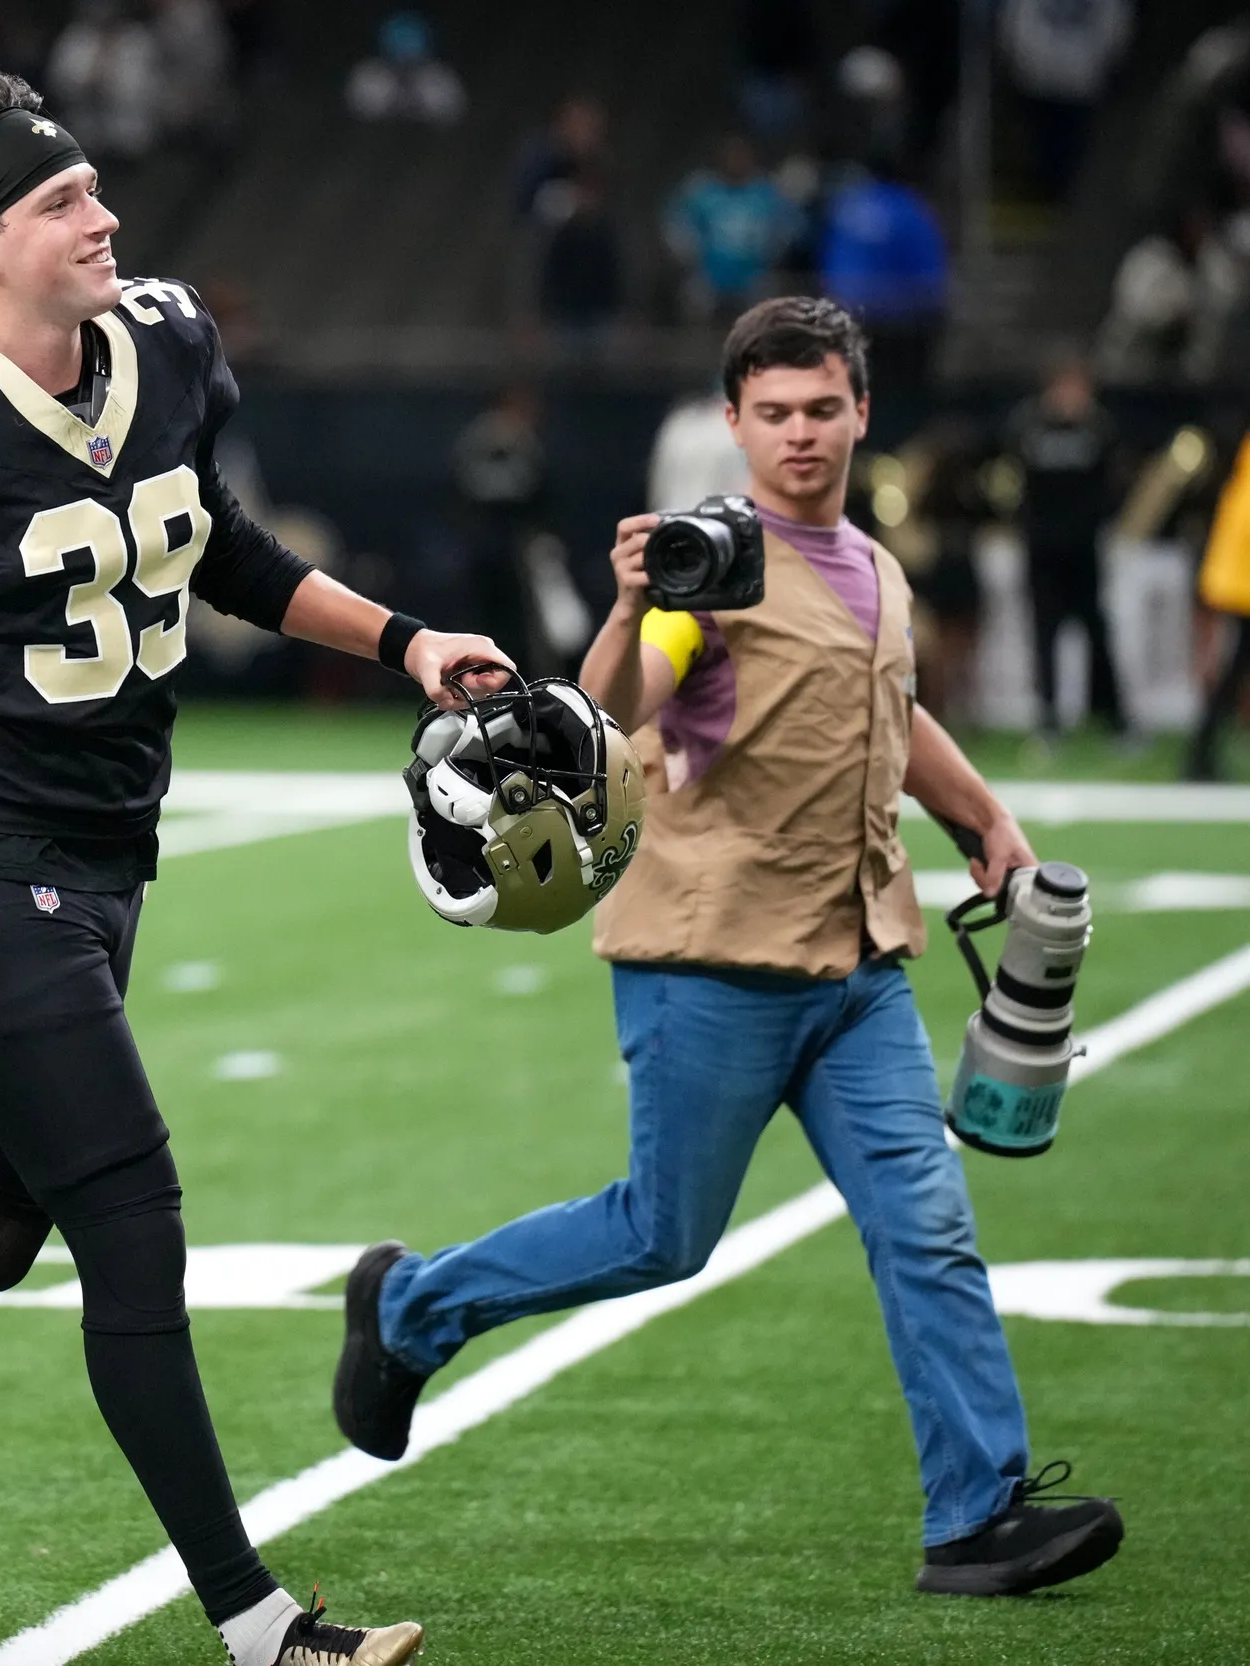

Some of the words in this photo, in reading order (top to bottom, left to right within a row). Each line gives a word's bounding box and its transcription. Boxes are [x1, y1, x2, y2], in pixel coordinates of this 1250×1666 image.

[92, 448, 111, 464] NFL
[18, 463, 212, 705] 39
[37, 893, 57, 907] NFL
